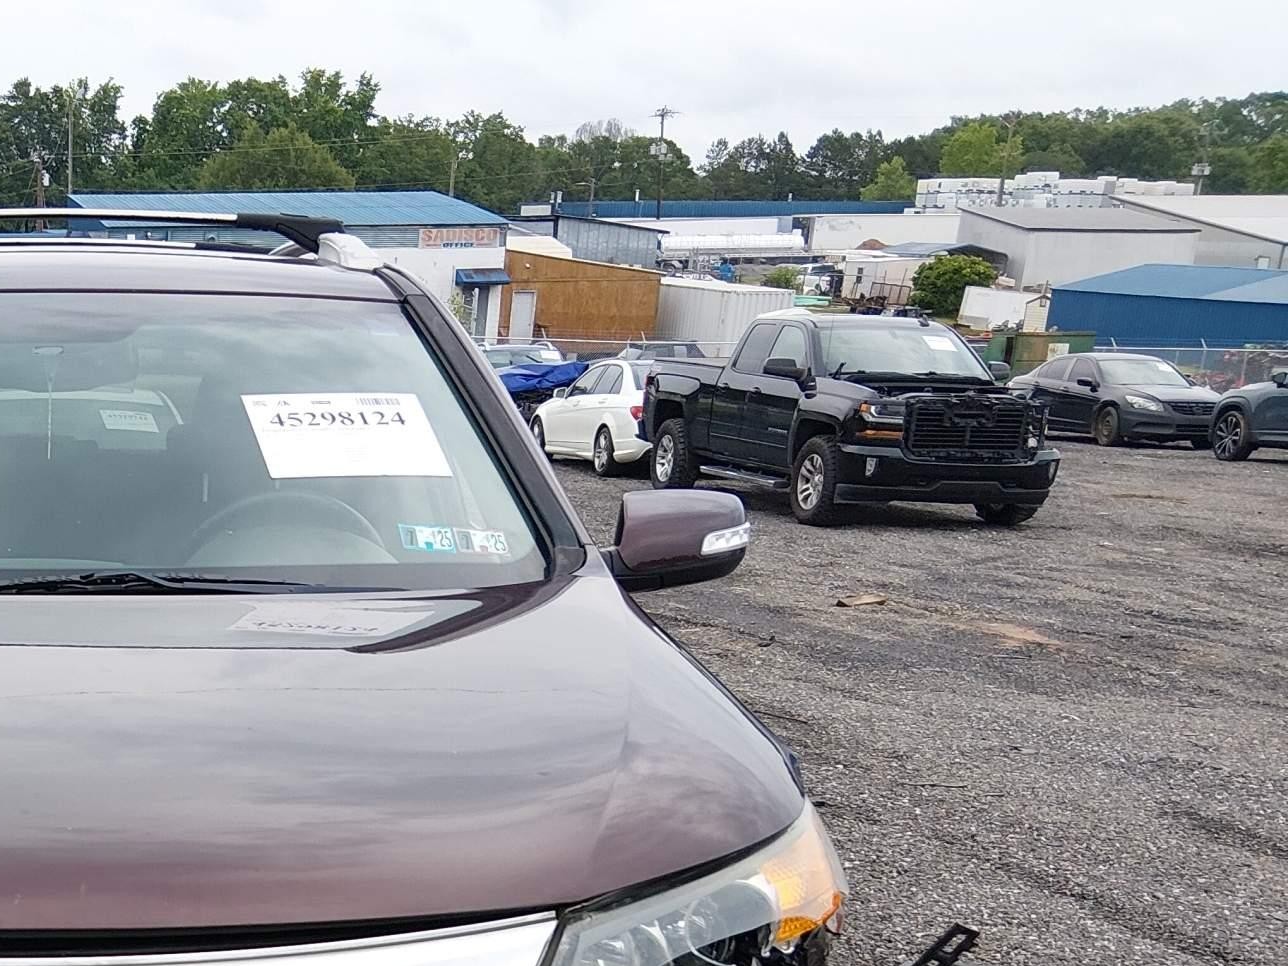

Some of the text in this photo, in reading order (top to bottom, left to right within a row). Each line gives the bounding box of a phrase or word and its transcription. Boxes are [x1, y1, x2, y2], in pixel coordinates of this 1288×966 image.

[422, 229, 498, 241] SADISCO
[269, 411, 406, 427] 45298124
[437, 530, 453, 548] 25
[490, 534, 507, 552] 25
